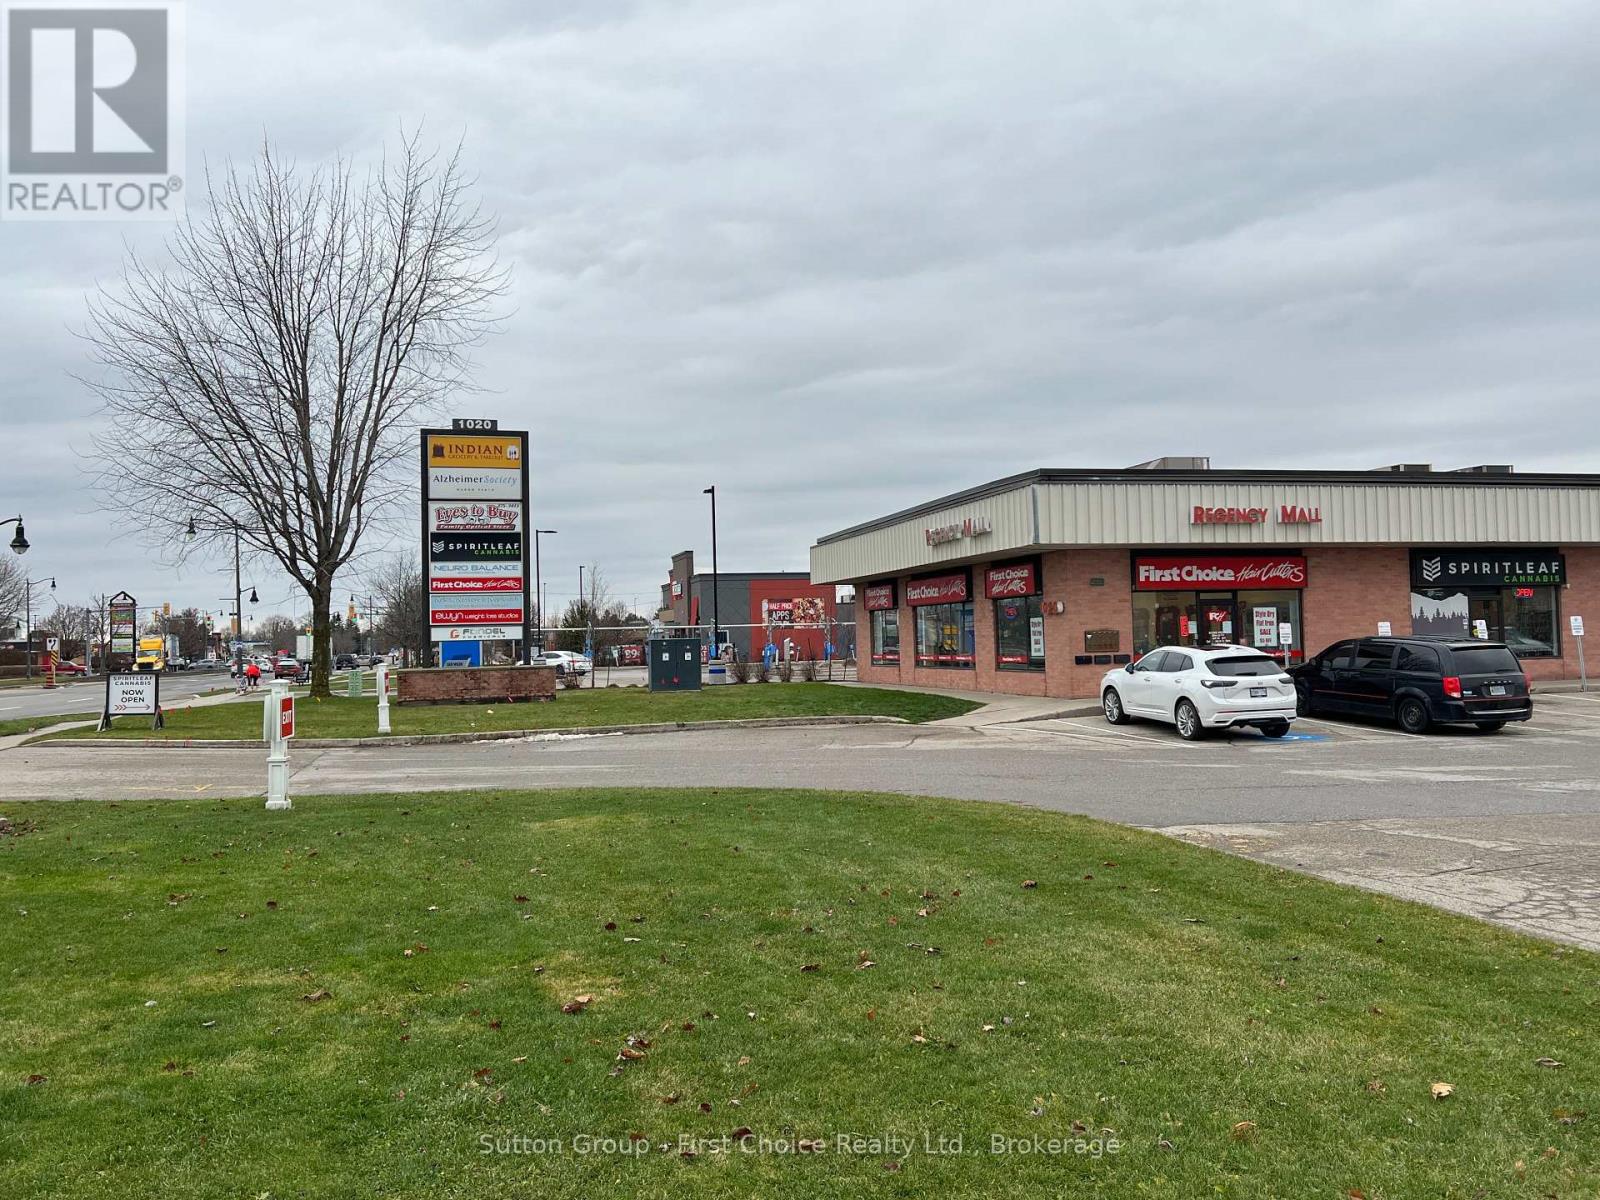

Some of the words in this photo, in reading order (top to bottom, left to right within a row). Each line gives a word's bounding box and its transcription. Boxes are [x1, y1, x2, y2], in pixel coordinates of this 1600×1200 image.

[458, 420, 492, 429] 1020
[448, 444, 503, 455] INDIAN
[435, 506, 468, 523] Eyes
[471, 504, 484, 517] to
[486, 504, 519, 525] Buy
[1192, 506, 1268, 524] REGENCY
[1280, 505, 1322, 523] MALL
[433, 564, 469, 572] NEURO
[1139, 565, 1180, 581] First
[1181, 565, 1235, 581] Choice
[1448, 562, 1560, 574] SPIRITLEAF
[990, 571, 1006, 581] First
[1005, 568, 1029, 579] Choice
[1504, 575, 1560, 583] CANNABIS
[453, 580, 483, 588] Choice
[1515, 588, 1535, 598] OPEN
[769, 602, 780, 610] HALF
[772, 611, 790, 620] APPS
[282, 710, 292, 724] EXIT
